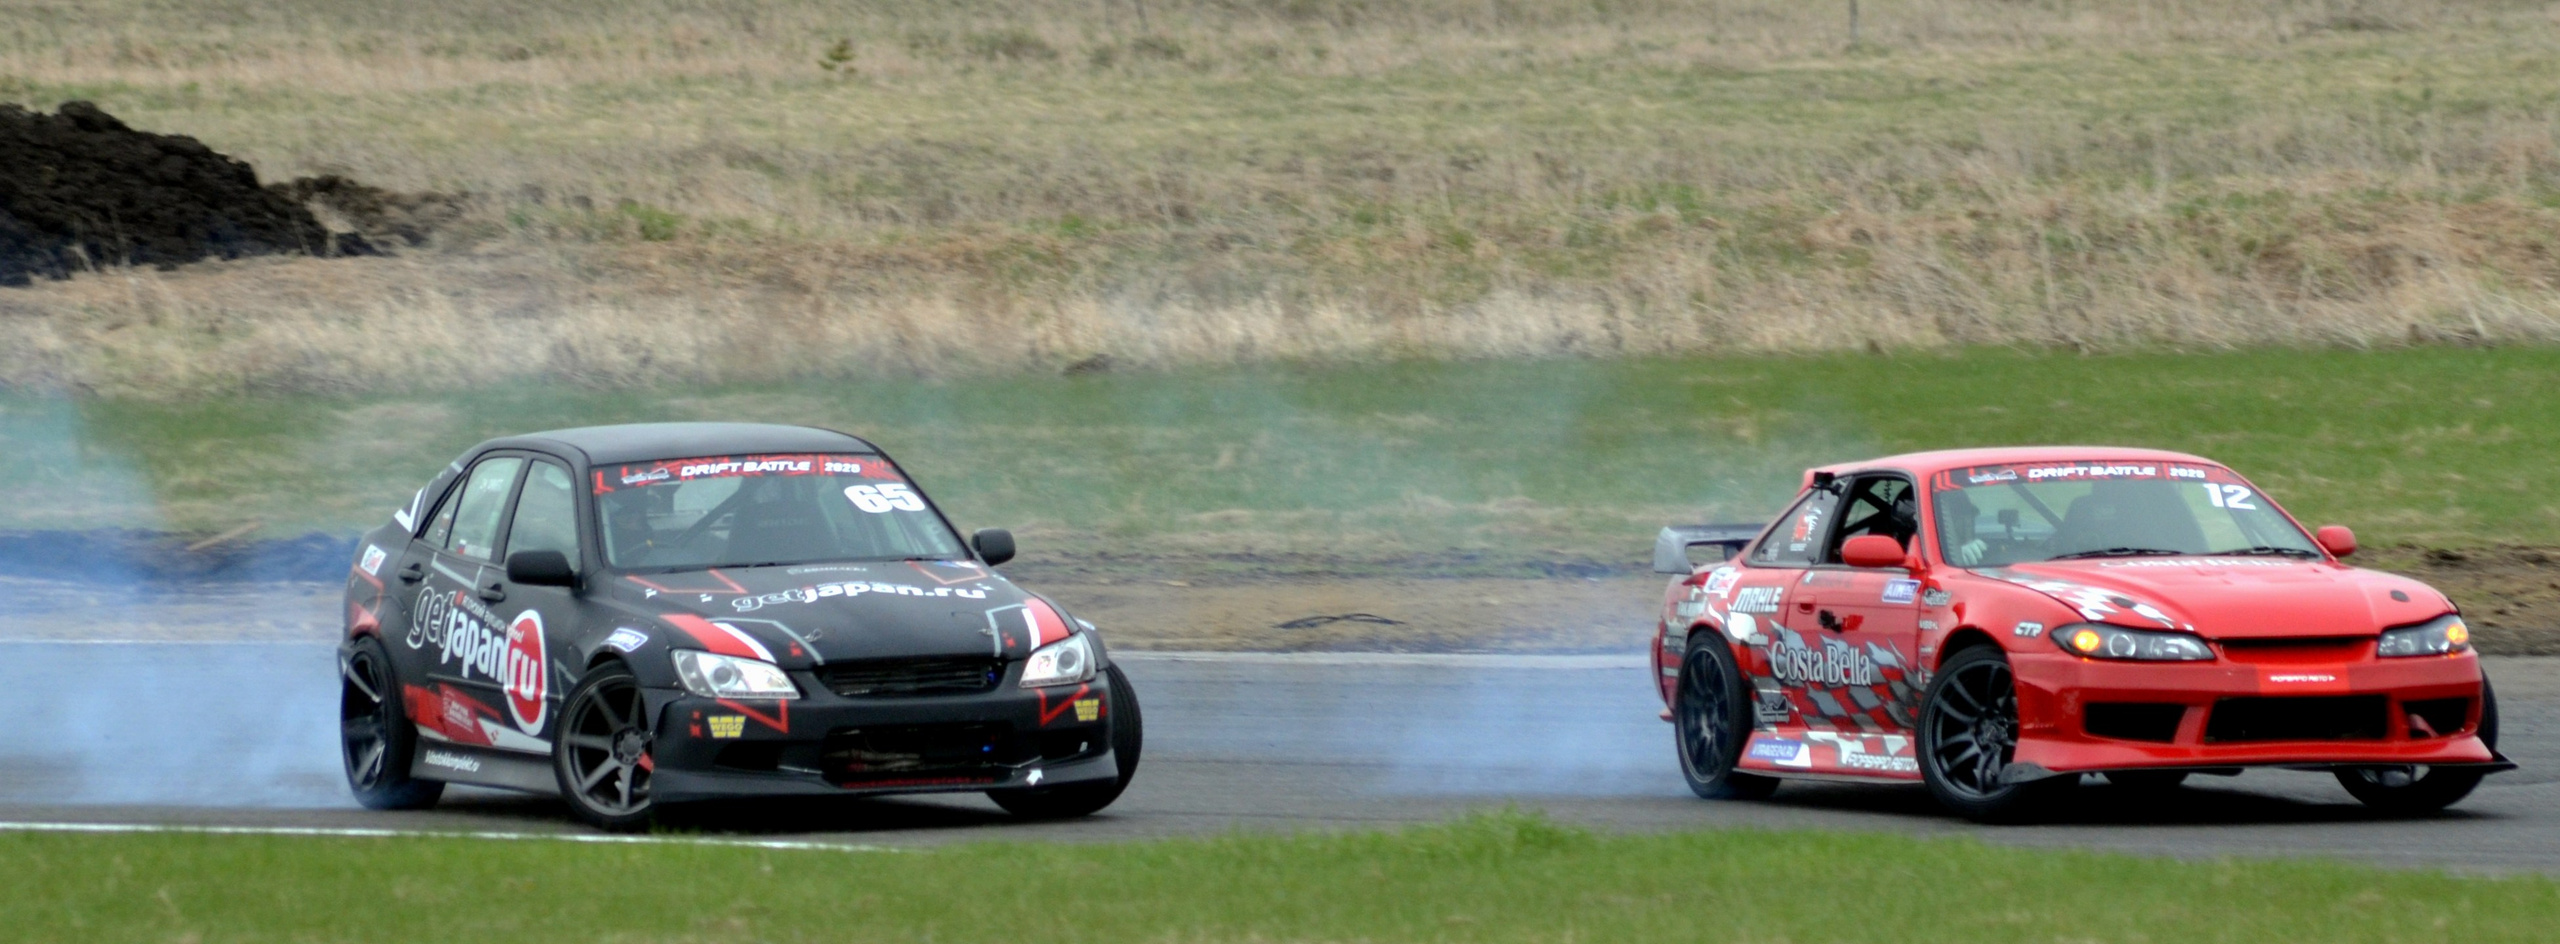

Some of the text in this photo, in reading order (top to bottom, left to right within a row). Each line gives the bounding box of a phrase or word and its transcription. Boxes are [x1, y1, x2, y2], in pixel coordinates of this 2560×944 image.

[681, 461, 742, 477] DRIFT
[743, 460, 811, 472] BATTLE
[824, 462, 861, 473] 2025
[2028, 466, 2089, 479] DRIFT
[2089, 466, 2156, 476] BATTLE
[2169, 467, 2206, 479] 2025
[843, 483, 926, 514] 65
[2203, 482, 2257, 510] 12
[731, 581, 987, 612] getjapan.ru
[1731, 586, 1784, 613] MAHLE
[1771, 640, 1872, 686] Costa Bella
[710, 723, 743, 732] WEGO
